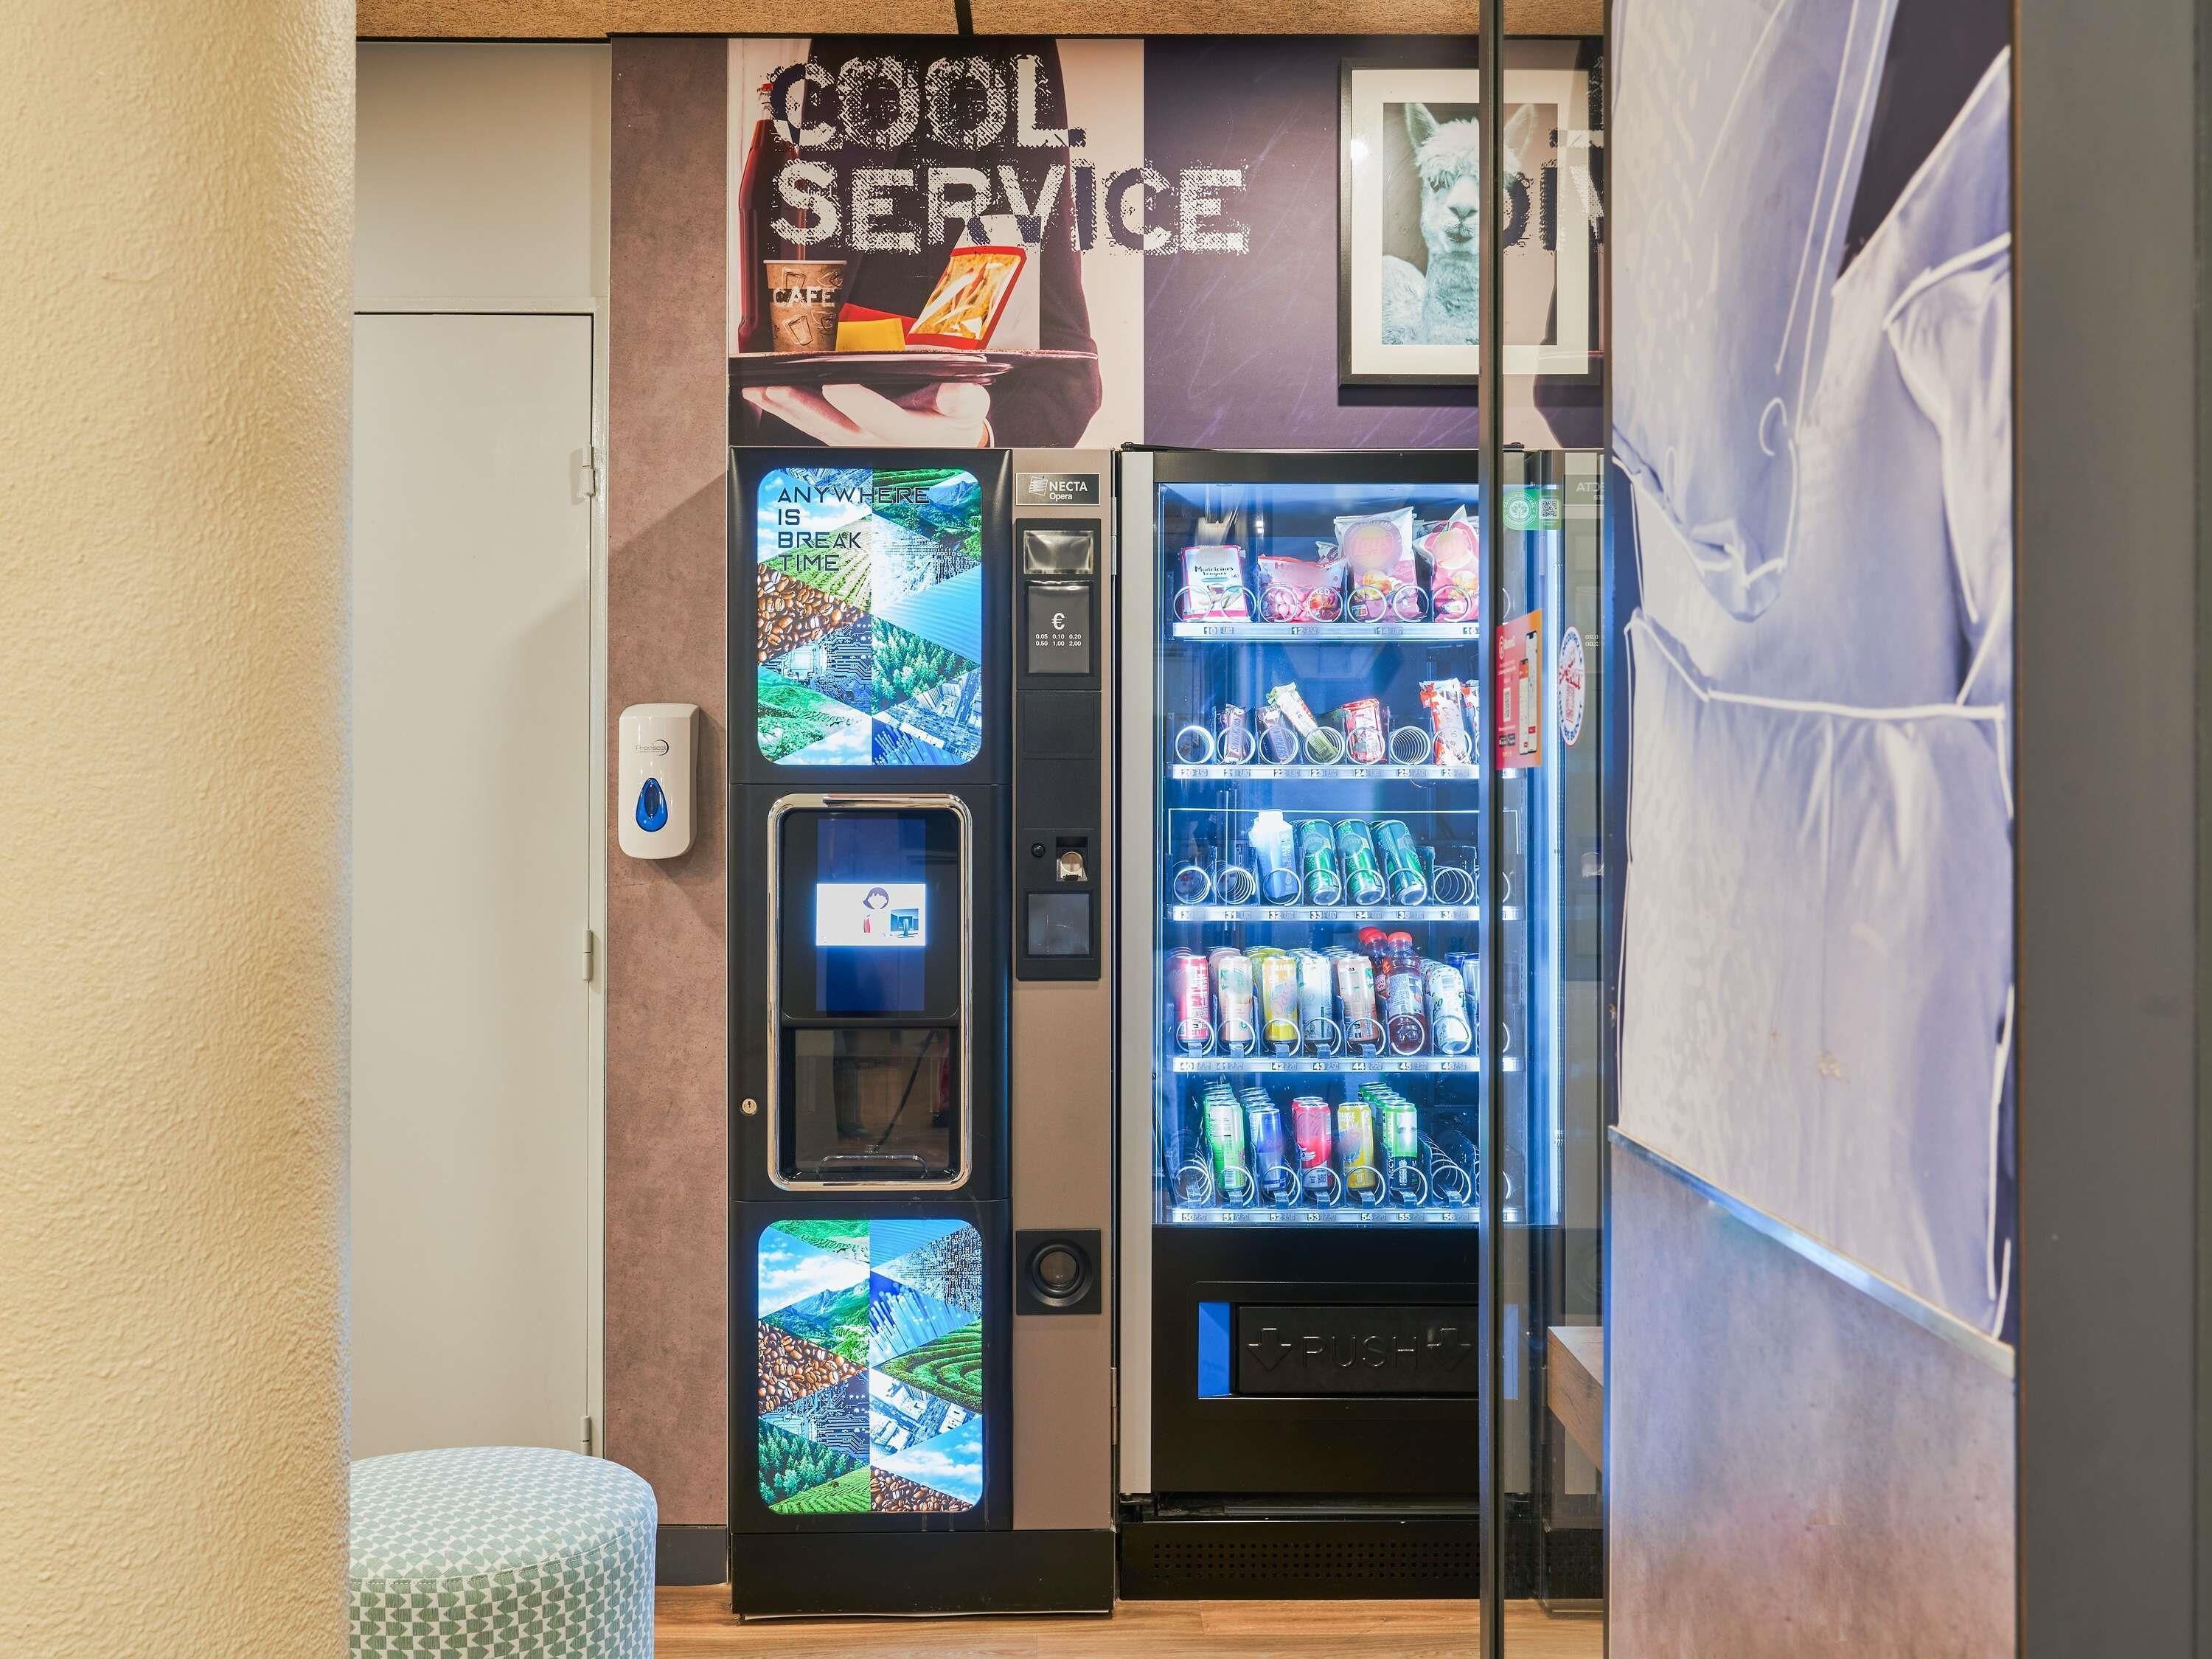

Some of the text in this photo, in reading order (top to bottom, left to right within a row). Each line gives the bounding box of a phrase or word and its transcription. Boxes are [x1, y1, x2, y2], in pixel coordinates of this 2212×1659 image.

[770, 55, 1086, 152] COOL
[771, 160, 1249, 255] SERVICE
[1049, 481, 1088, 492] NECTA
[778, 487, 931, 504] ANYWHERE
[1049, 493, 1073, 501] Opera
[778, 509, 800, 525] IS
[778, 532, 862, 549] BREAK
[778, 554, 840, 571] TIME
[1051, 613, 1065, 630] €
[1182, 1213, 1194, 1221] 50
[1223, 1213, 1236, 1221] 51
[1270, 1213, 1282, 1221] 52
[1307, 1213, 1320, 1221] 53
[1360, 1213, 1373, 1221] 54
[1398, 1213, 1410, 1221] 55
[1442, 1213, 1455, 1221] 56
[1302, 1335, 1419, 1370] PUSH
